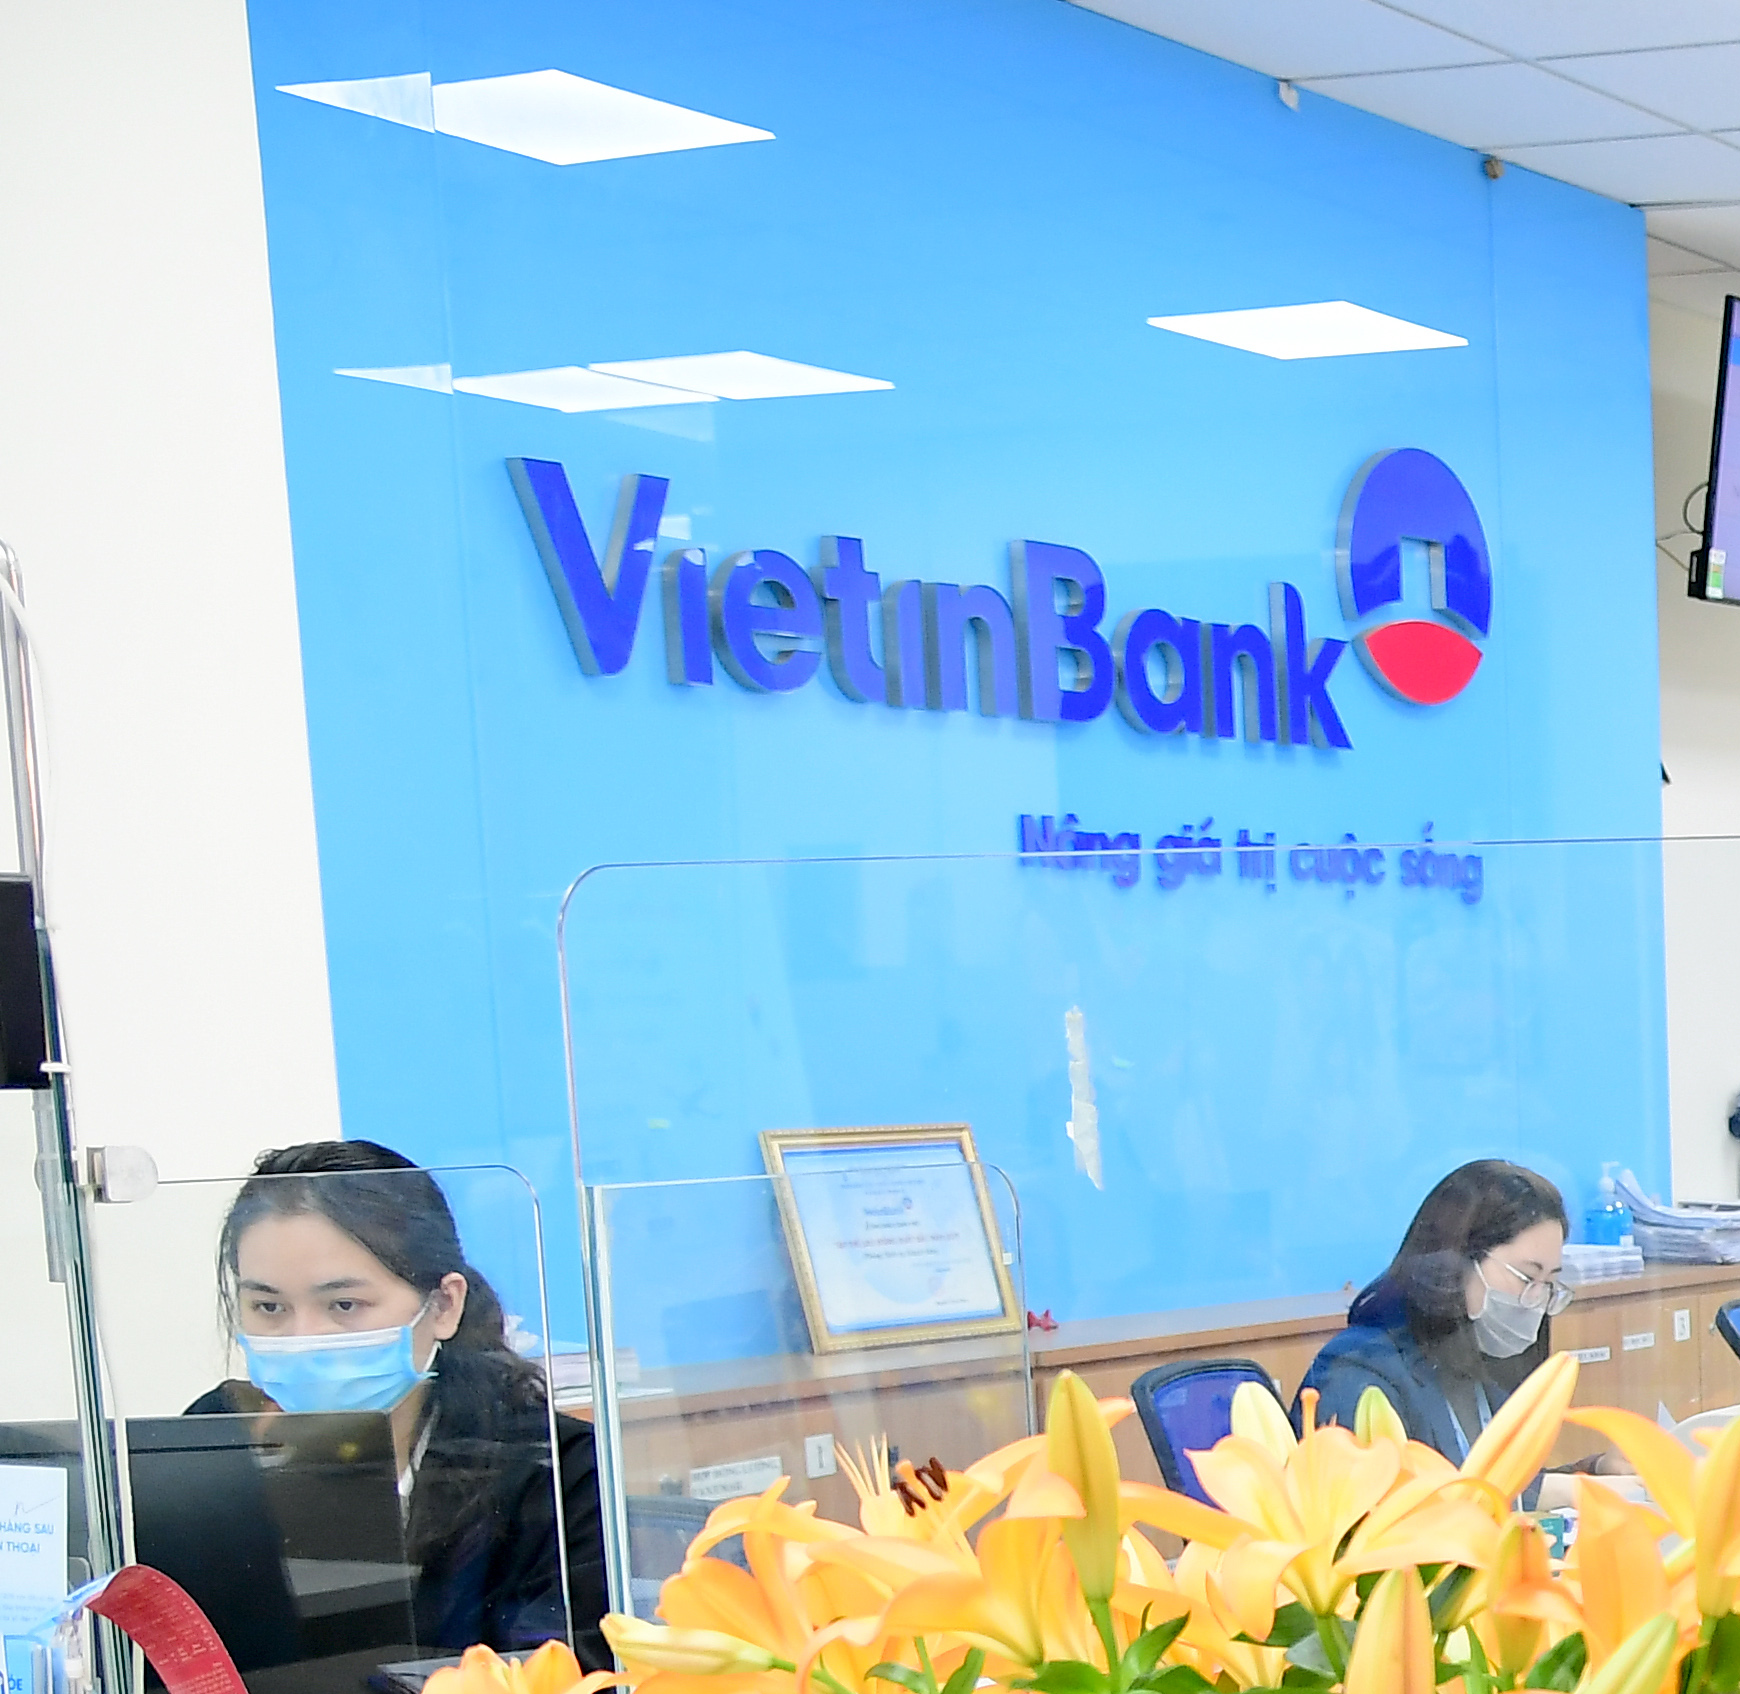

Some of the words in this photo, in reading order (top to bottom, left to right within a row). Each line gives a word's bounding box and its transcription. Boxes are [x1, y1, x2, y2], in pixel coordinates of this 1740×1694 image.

[504, 456, 1352, 752] VietinBank
[1019, 812, 1141, 890] Nâng
[1155, 815, 1223, 890] giá
[1235, 826, 1277, 895] trị
[1287, 831, 1386, 902] cuộc
[1398, 820, 1484, 906] sống
[6, 1541, 41, 1555] THOẠI
[34, 1522, 55, 1535] SAU
